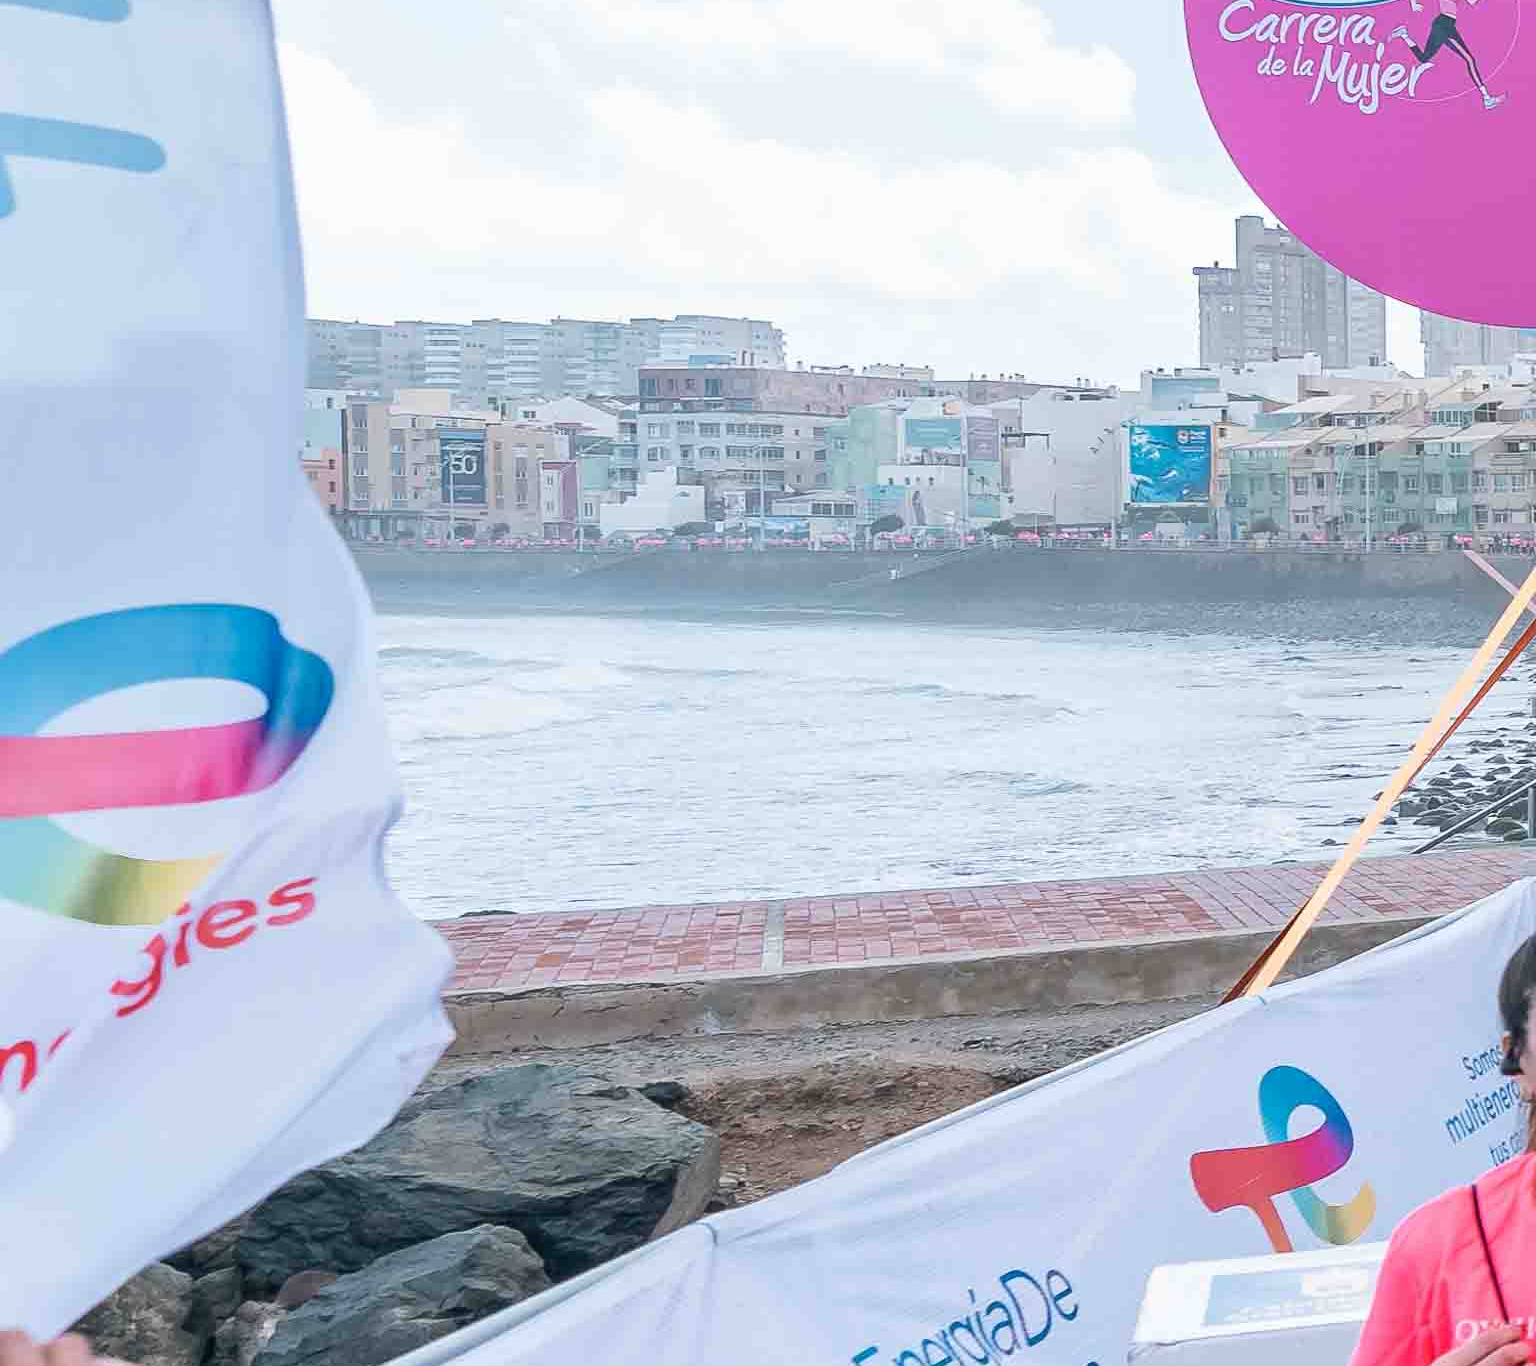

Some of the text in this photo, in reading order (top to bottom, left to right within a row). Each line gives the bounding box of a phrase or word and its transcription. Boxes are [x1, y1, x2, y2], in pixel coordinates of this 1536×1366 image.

[1218, 0, 1376, 44] Carrera
[1256, 43, 1435, 115] de la Mujer
[1461, 1043, 1504, 1080] Somo
